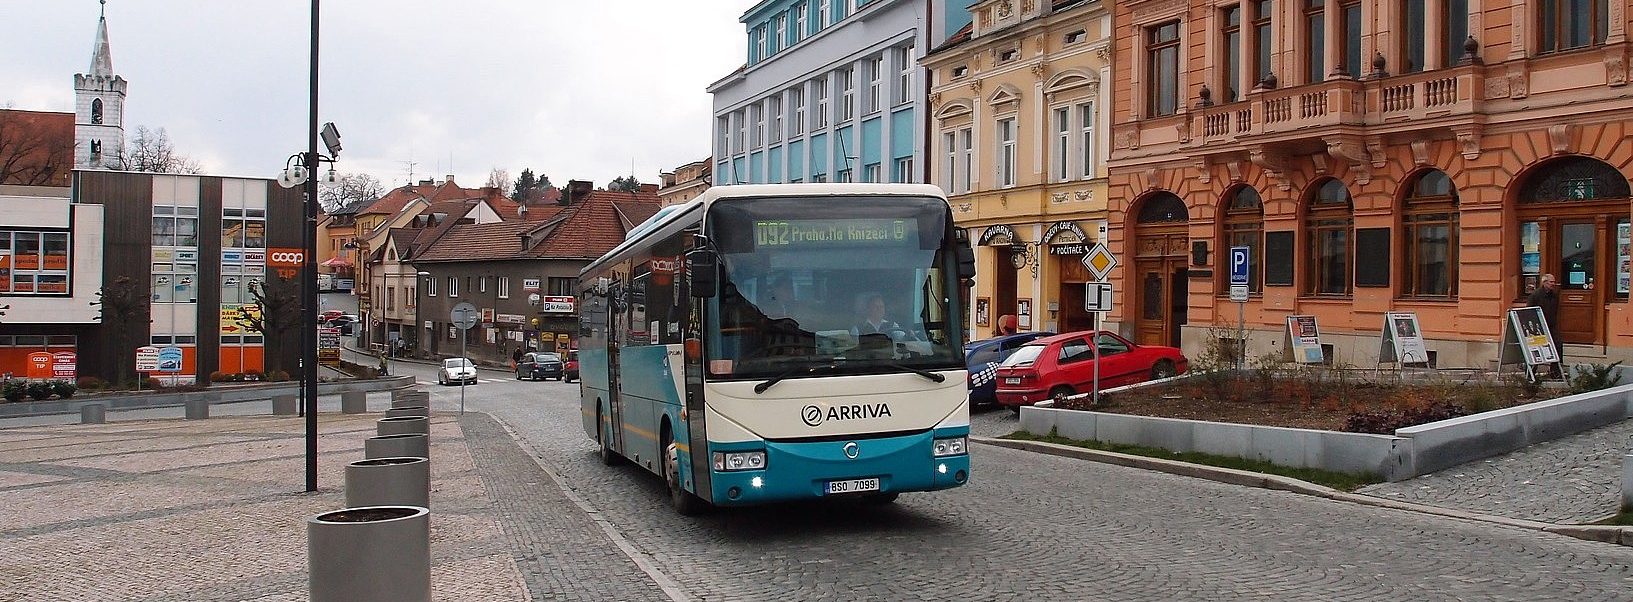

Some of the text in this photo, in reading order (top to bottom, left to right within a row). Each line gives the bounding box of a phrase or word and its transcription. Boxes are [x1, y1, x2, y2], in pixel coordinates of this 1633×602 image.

[271, 252, 304, 265] coop
[1234, 251, 1245, 273] P
[826, 403, 892, 421] ARRIVA
[854, 480, 875, 490] 7099
